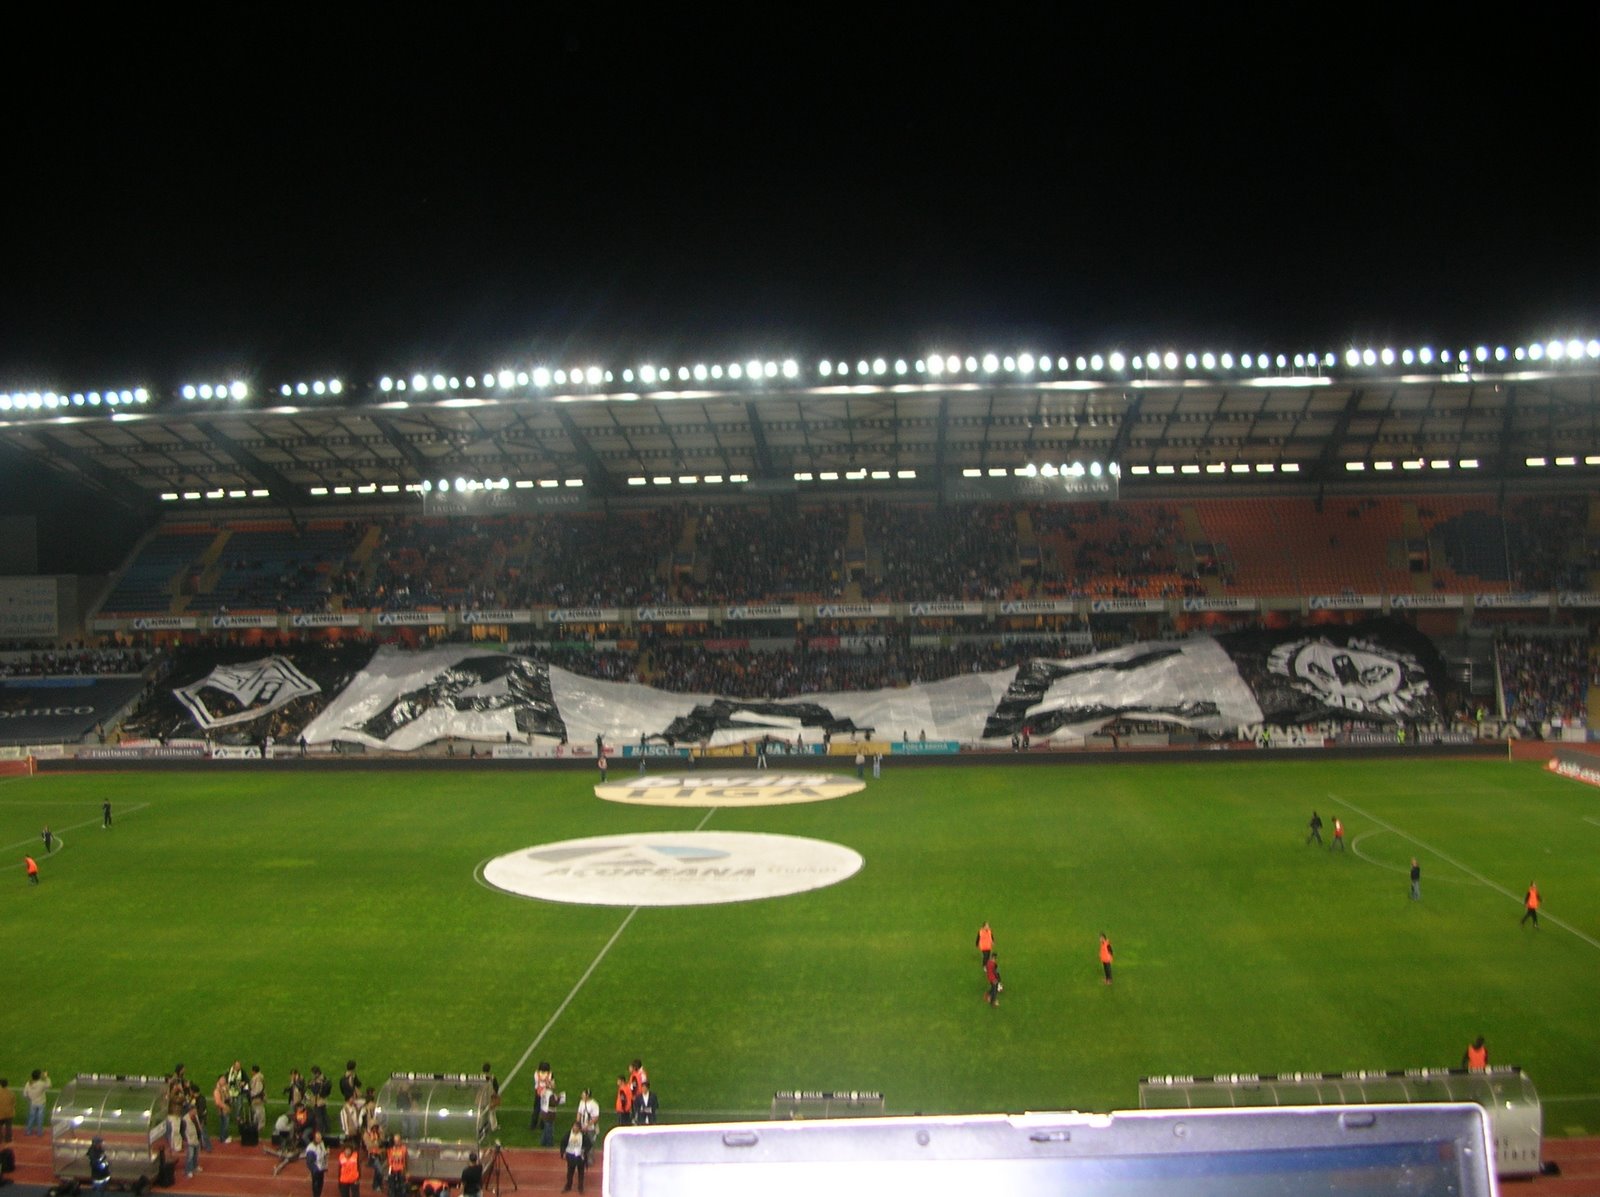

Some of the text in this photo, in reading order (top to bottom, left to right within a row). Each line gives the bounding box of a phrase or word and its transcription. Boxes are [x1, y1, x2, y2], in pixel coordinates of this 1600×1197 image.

[536, 495, 580, 505] VOLVO
[92, 748, 139, 758] Finibanco
[155, 747, 200, 757] Finibanco
[626, 787, 823, 799] LIGA
